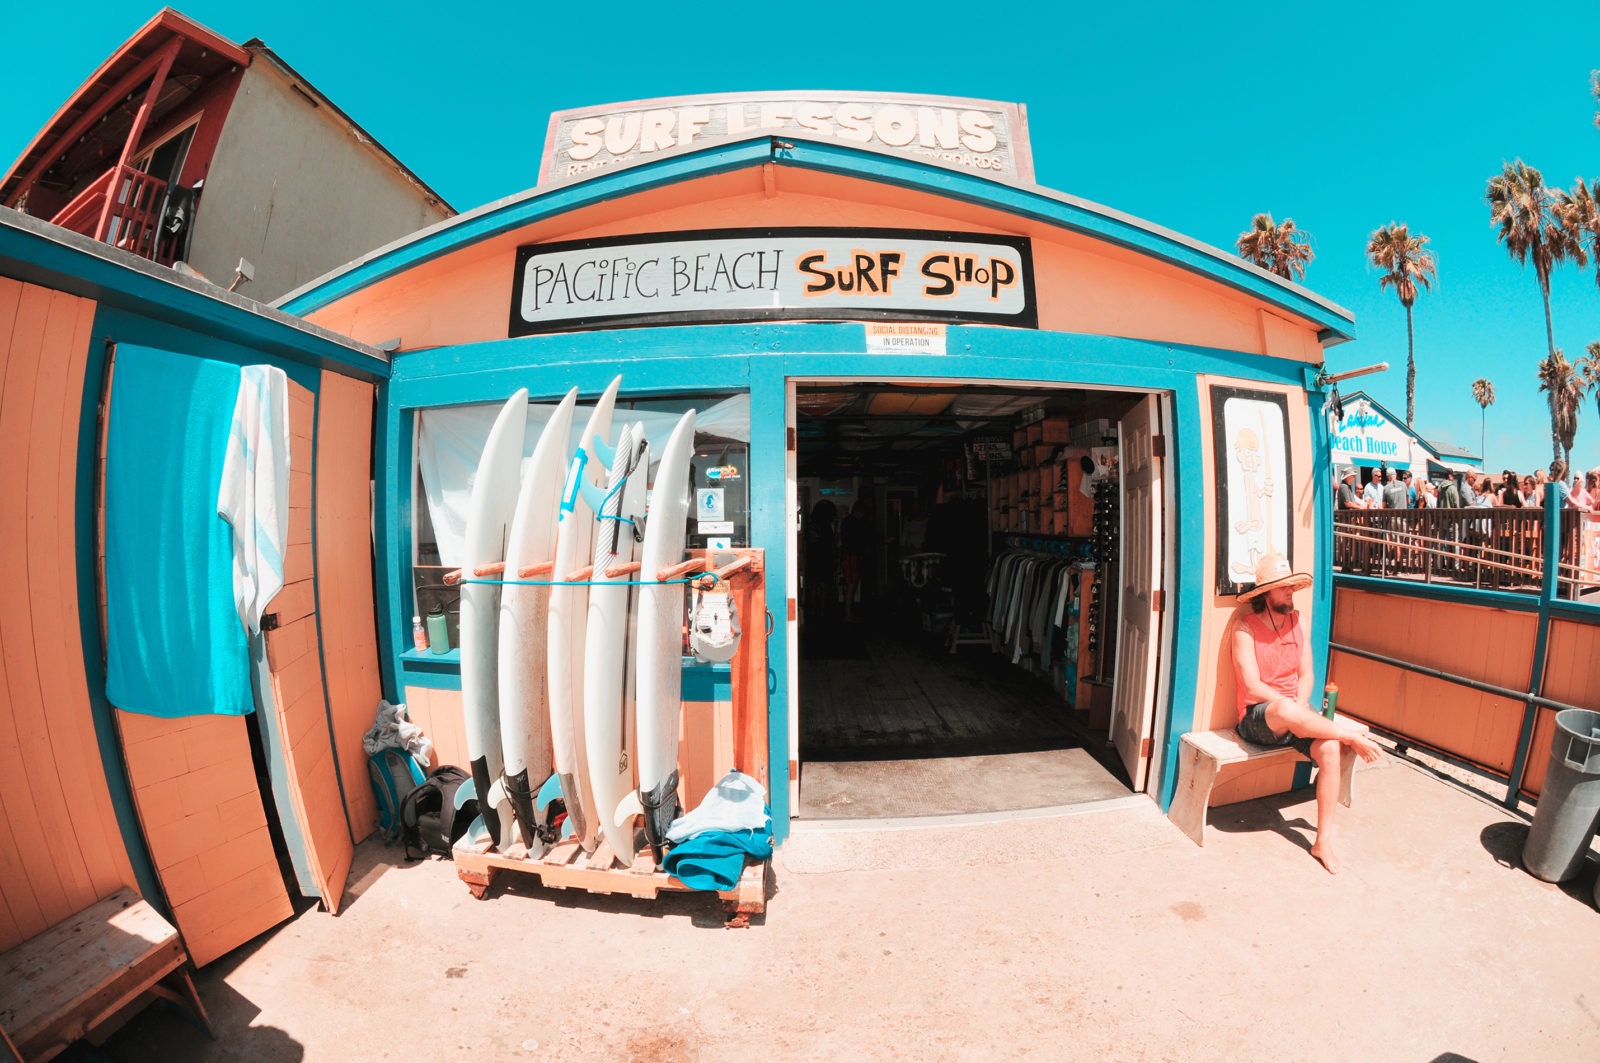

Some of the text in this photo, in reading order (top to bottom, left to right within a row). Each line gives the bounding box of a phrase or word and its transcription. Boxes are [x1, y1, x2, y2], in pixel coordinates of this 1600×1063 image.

[567, 102, 998, 161] SURF LESSONS
[670, 250, 783, 297] BEACH
[921, 255, 1014, 299] SHOP
[873, 326, 896, 334] SOCIAL
[883, 338, 930, 347] IN OPERATION
[1366, 436, 1398, 456] House
